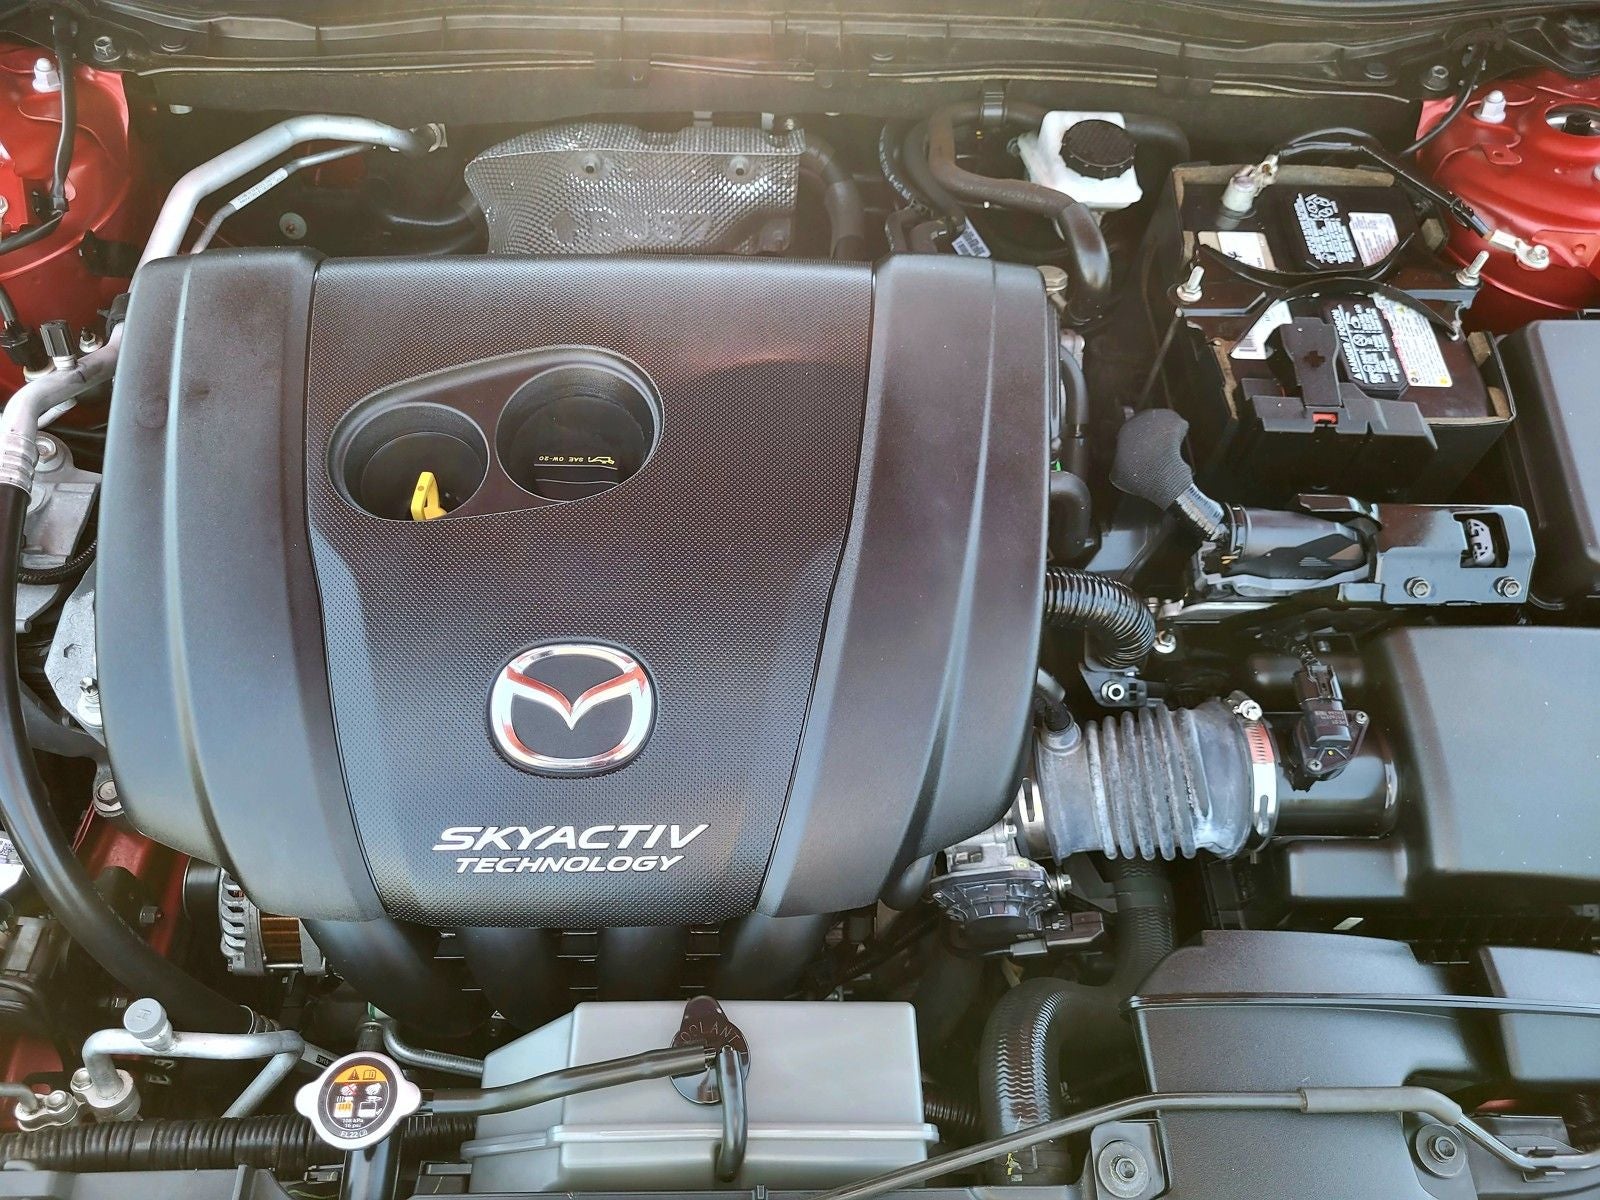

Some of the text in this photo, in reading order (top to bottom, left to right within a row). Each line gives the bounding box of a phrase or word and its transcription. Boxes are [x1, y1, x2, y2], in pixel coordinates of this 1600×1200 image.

[1331, 308, 1348, 336] POISON
[1342, 342, 1359, 373] DANGER
[432, 824, 709, 851] SKYACTIV
[456, 855, 684, 873] TECHNOLOGY
